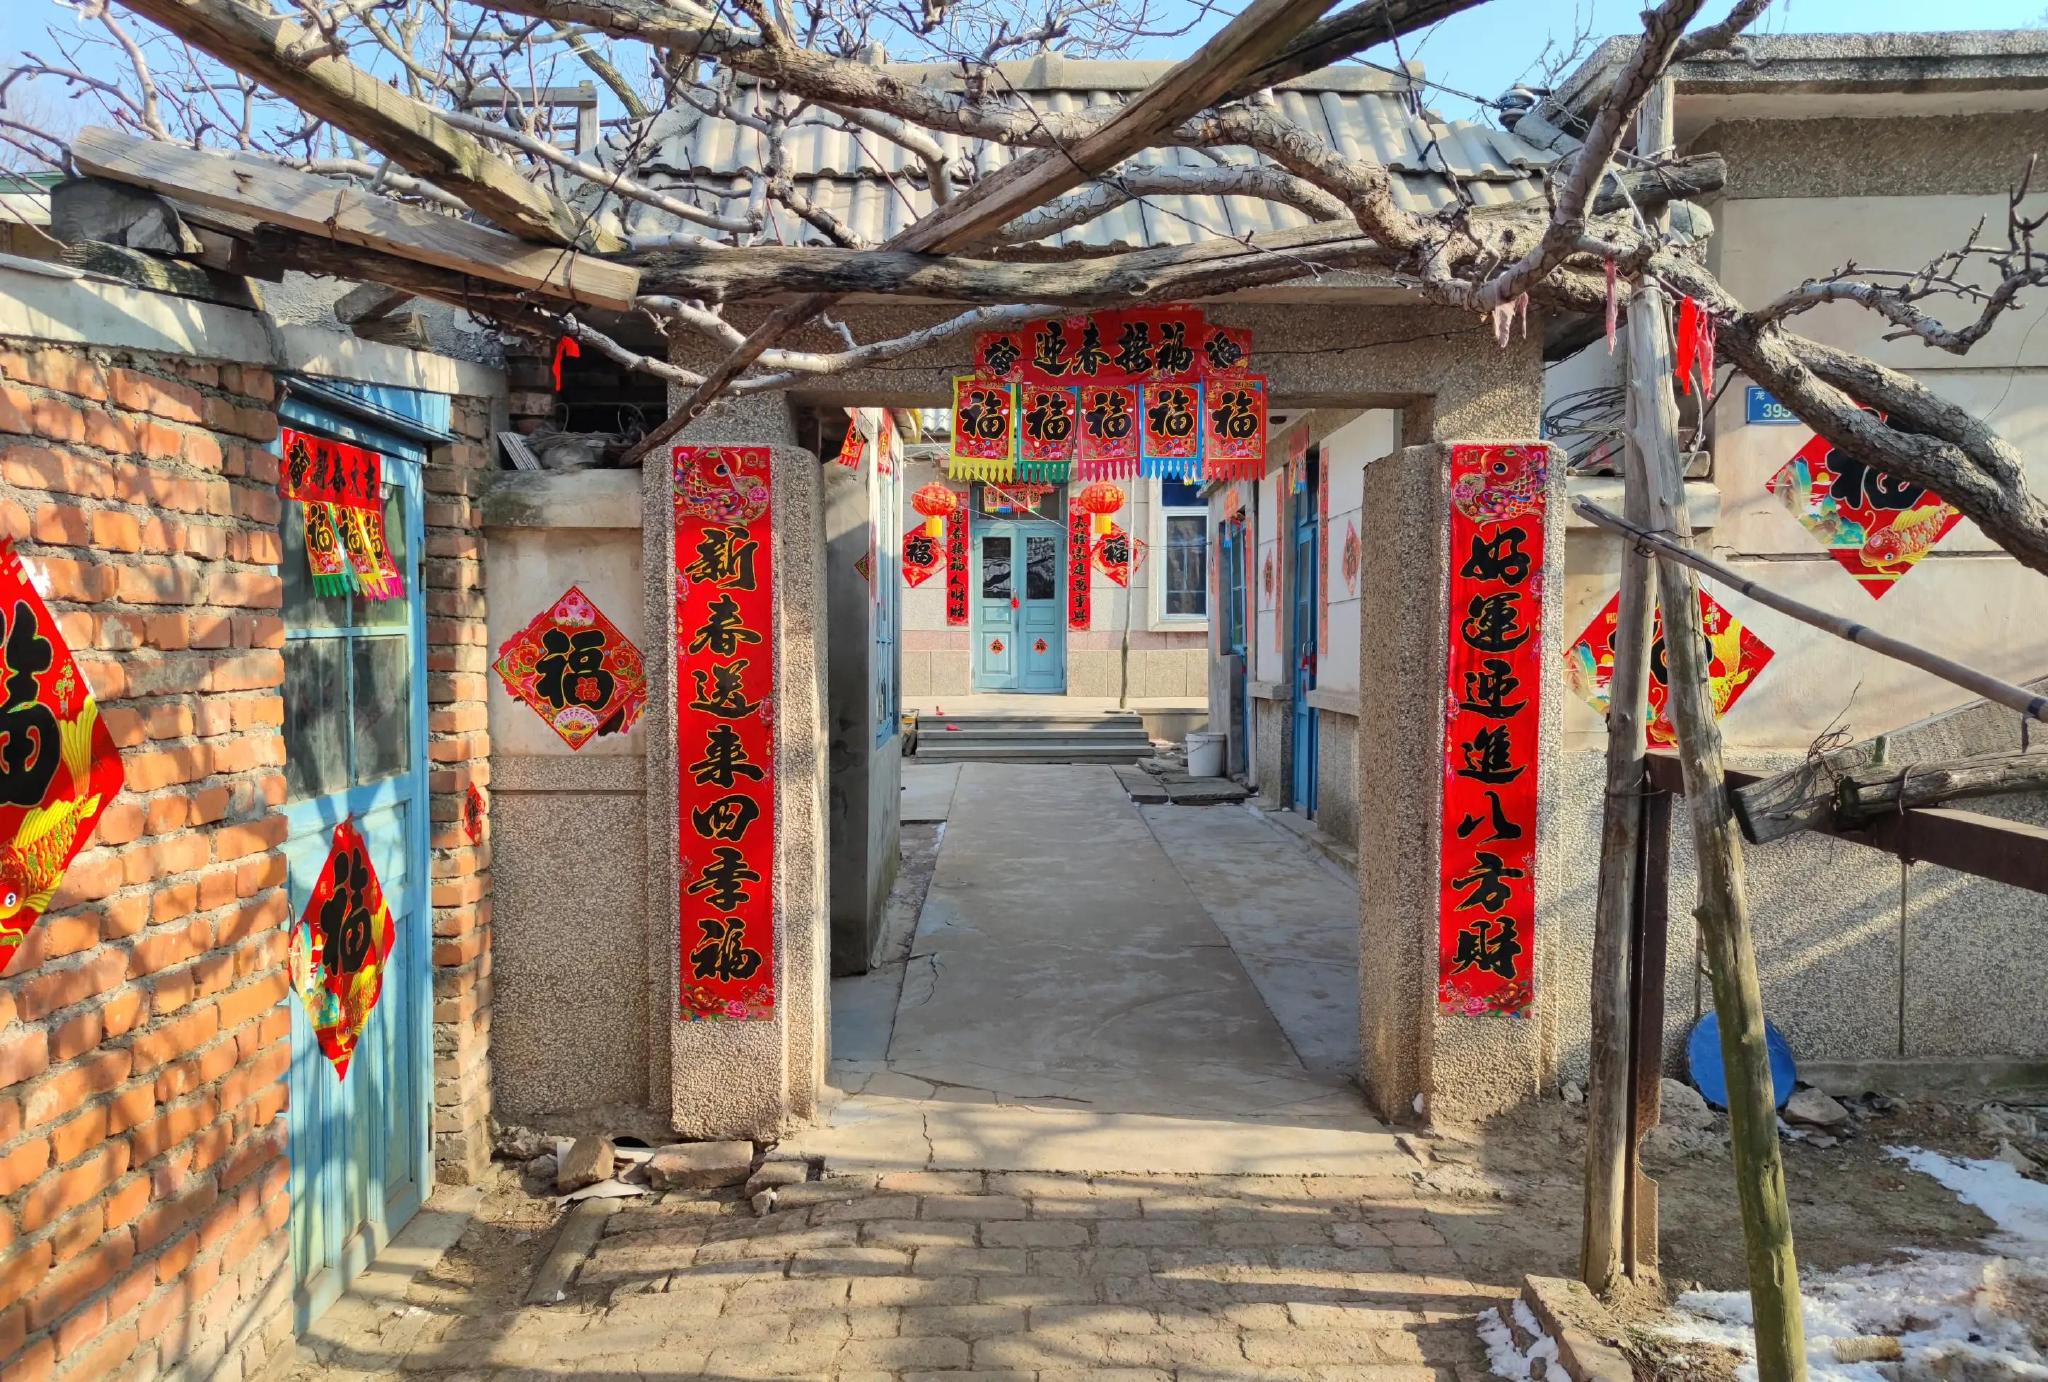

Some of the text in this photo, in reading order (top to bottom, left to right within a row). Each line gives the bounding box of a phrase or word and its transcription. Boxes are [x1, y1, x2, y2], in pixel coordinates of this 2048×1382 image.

[1031, 320, 1195, 377] 迎春接福
[959, 390, 1007, 440] 福
[1025, 391, 1073, 441] 福
[1085, 391, 1133, 440] 福
[1147, 387, 1195, 438] 福
[1211, 390, 1259, 440] 福
[306, 502, 335, 554] 福
[338, 507, 366, 555] 福
[905, 535, 934, 567] 福
[1102, 534, 1129, 567] 福
[535, 627, 616, 711] 福
[574, 676, 601, 702] 福
[319, 846, 372, 976] 福
